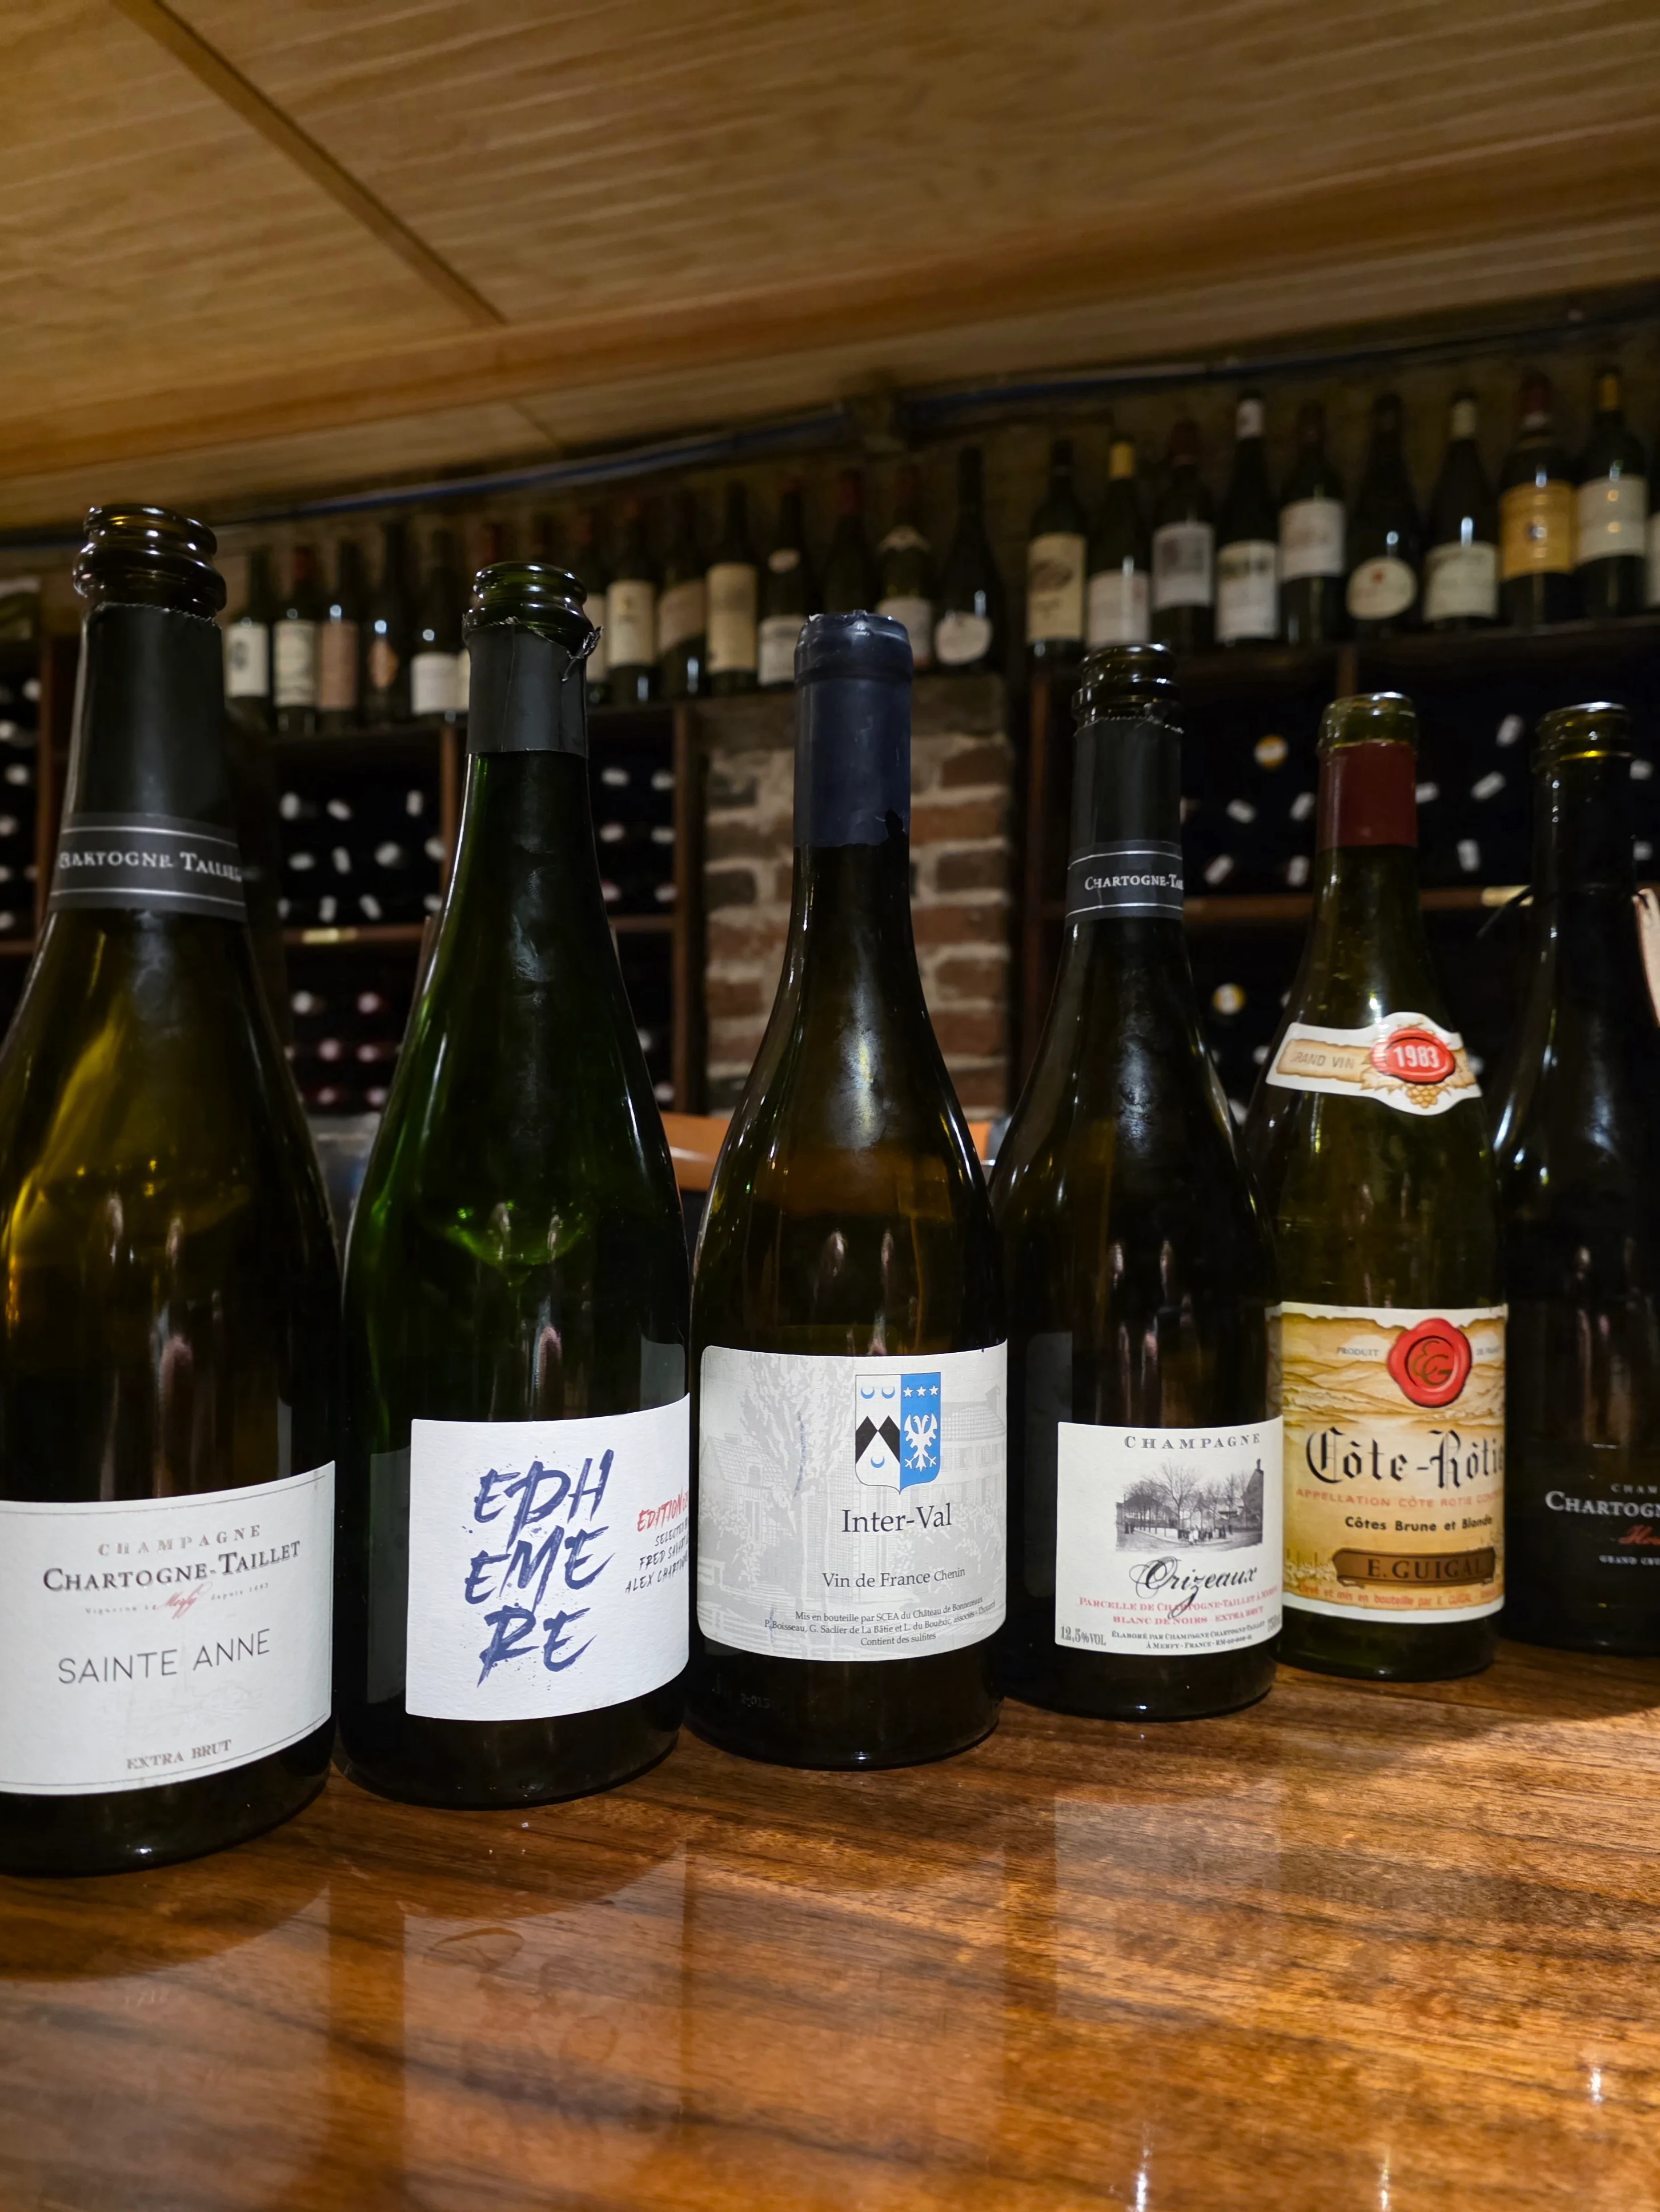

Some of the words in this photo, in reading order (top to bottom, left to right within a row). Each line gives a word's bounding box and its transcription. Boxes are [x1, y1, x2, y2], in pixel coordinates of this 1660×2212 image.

[179, 851, 242, 882] TAILLE
[1085, 873, 1184, 891] CHARTOGNE-TA
[1332, 1056, 1356, 1069] VIN
[1394, 1044, 1440, 1069] 1983
[1337, 1347, 1380, 1357] PRODUIT
[1124, 1433, 1261, 1450] CHAMPAGNE
[1296, 1488, 1392, 1506] APPELLATION
[1398, 1495, 1434, 1508] CÔTE
[1610, 1482, 1660, 1495] CHAM
[474, 1448, 615, 1554] EPH
[637, 1486, 683, 1532] EDITION
[841, 1502, 952, 1533] Inter-Val
[1345, 1516, 1387, 1530] Côtes
[1395, 1520, 1437, 1532] Brune
[1444, 1520, 1457, 1530] et
[98, 1524, 262, 1557] CHAMPAGNE
[43, 1541, 300, 1593] CHARTOGNE-TAILLET
[464, 1525, 616, 1614] EME
[639, 1549, 665, 1571] FRED
[1392, 1557, 1483, 1580] GUIGAL
[625, 1572, 655, 1595] ALEX
[823, 1573, 851, 1588] Vin
[856, 1573, 876, 1588] de
[880, 1572, 931, 1587] France
[933, 1567, 965, 1581] Chenin
[1129, 1556, 1258, 1620] Orizeaux
[795, 1610, 811, 1620] Mis
[824, 1613, 859, 1622] bouteille
[861, 1615, 875, 1624] par
[876, 1612, 900, 1621] SCEA
[901, 1611, 911, 1620] du
[913, 1608, 942, 1618] Château
[943, 1605, 952, 1614] de
[1079, 1597, 1137, 1610] PARCELLE
[1113, 1615, 1152, 1625] BLANC
[1173, 1616, 1208, 1625] NOIRS
[1215, 1610, 1245, 1622] EXTRA
[1245, 1605, 1264, 1617] BRUT
[772, 1621, 807, 1633] Boisseau,
[809, 1624, 819, 1633] G.
[820, 1625, 848, 1634] Saclier
[849, 1625, 860, 1634] de
[861, 1625, 872, 1634] La
[873, 1624, 893, 1633] Bâtie
[913, 1622, 923, 1630] du
[477, 1604, 598, 1688] RE
[860, 1637, 895, 1646] Contient
[896, 1636, 910, 1644] des
[911, 1633, 937, 1643] sulfites
[58, 1649, 178, 1685] SAINTE
[193, 1628, 270, 1672] ANNE
[126, 1750, 185, 1770] EXTRA
[191, 1738, 232, 1761] BRUT
